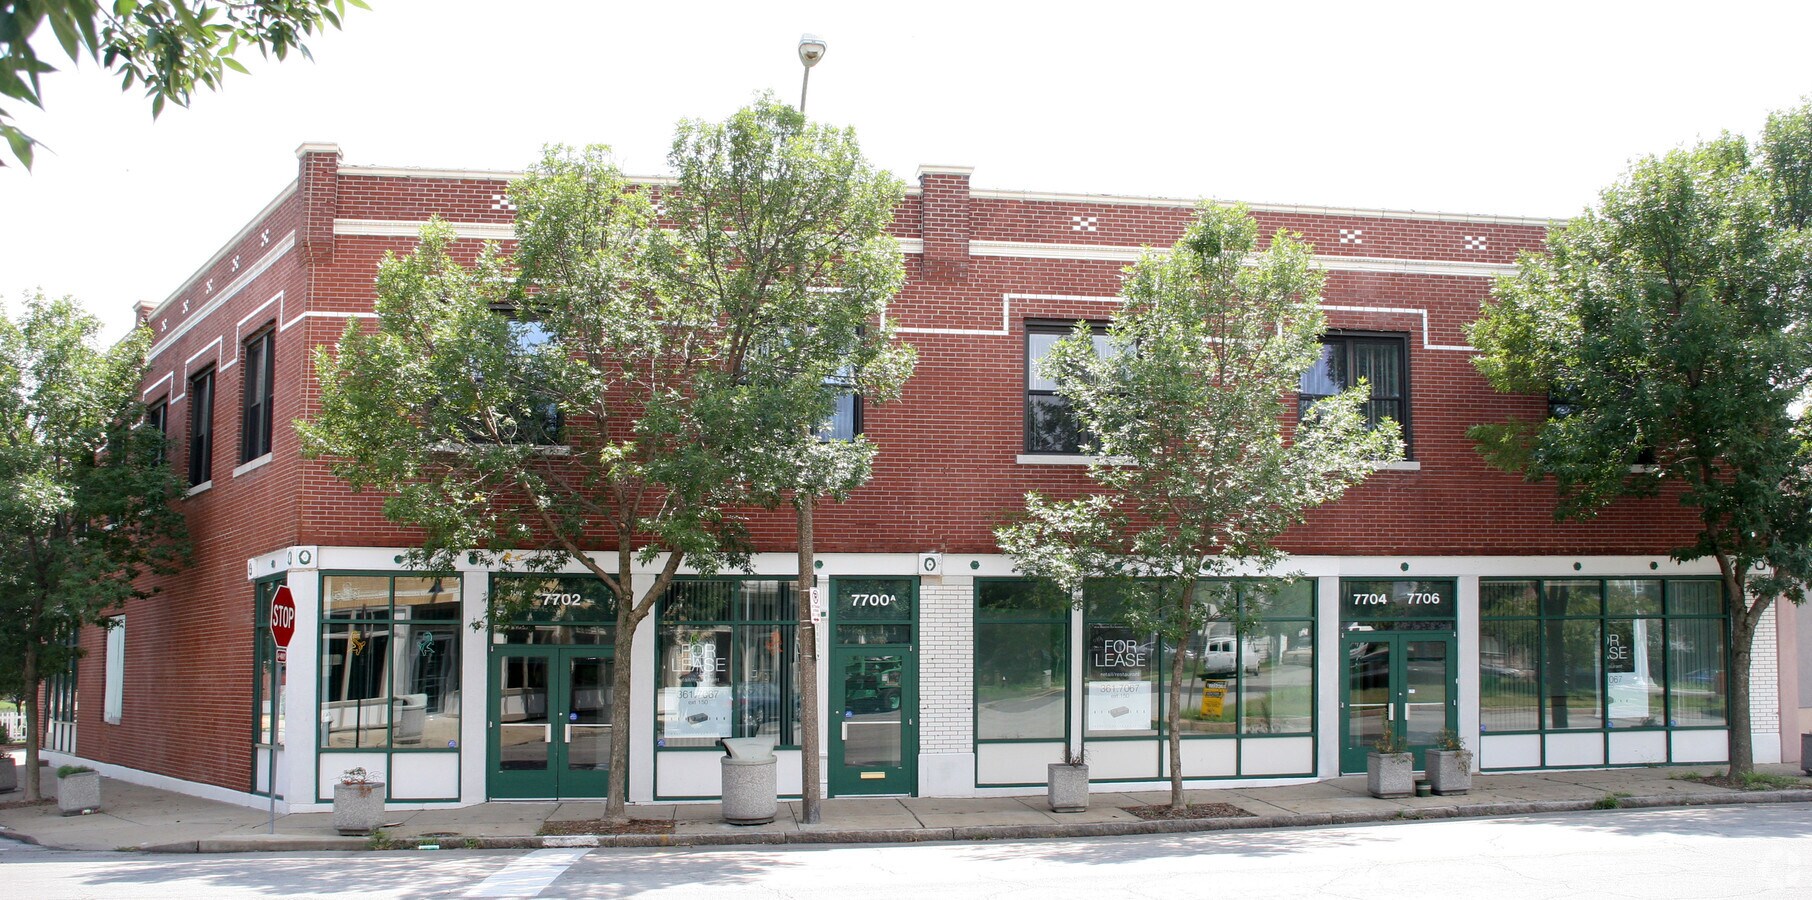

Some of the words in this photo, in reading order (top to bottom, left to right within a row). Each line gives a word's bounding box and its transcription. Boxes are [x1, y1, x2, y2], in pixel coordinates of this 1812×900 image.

[541, 593, 581, 606] 7702
[1353, 593, 1387, 605] 7704
[1407, 593, 1440, 604] 7706
[272, 604, 295, 629] STOP
[681, 643, 716, 658] FOR
[1104, 639, 1137, 653] FOR
[671, 657, 726, 672] LEASE
[1095, 653, 1146, 667] LEASE
